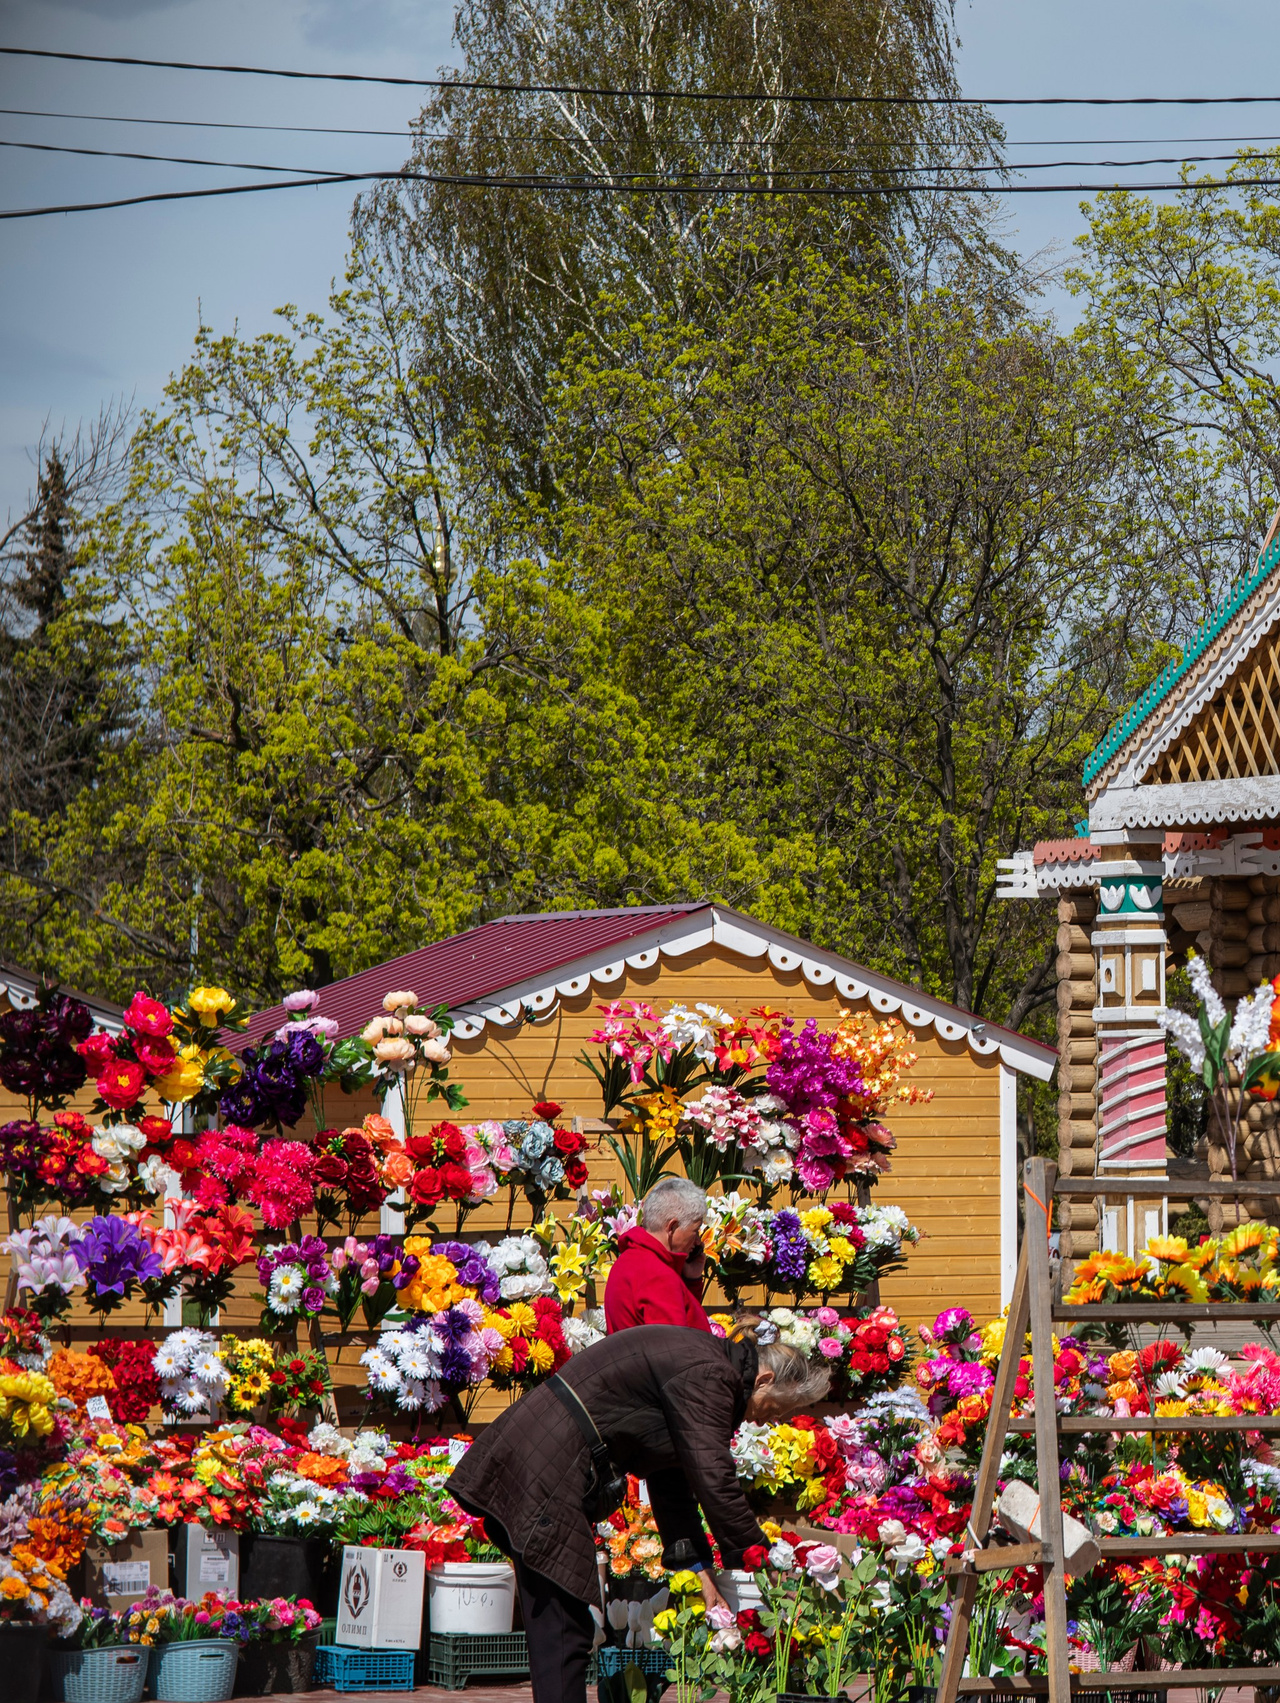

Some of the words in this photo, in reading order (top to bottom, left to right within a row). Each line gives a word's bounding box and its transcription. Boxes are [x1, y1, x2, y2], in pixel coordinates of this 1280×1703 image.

[91, 1405, 107, 1413] 200
[450, 1441, 465, 1453] 100
[341, 1623, 367, 1636] ОЛИМП
